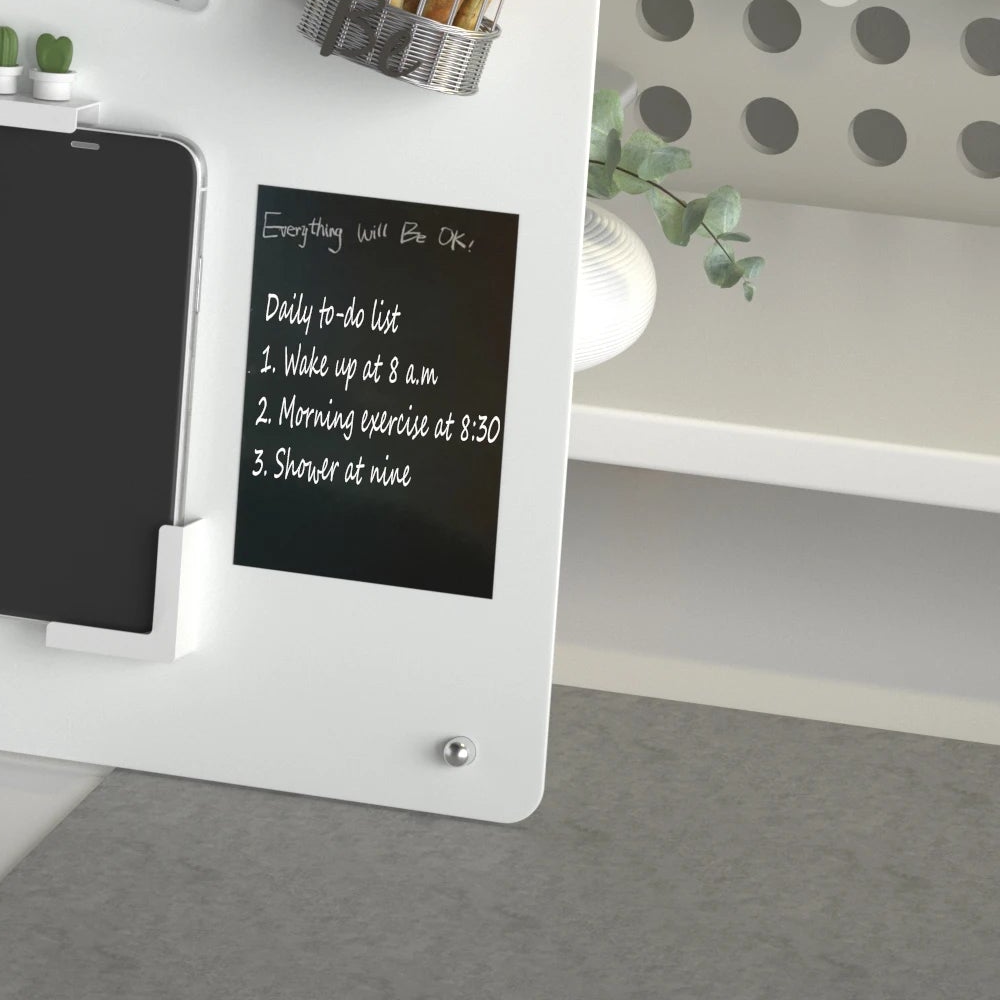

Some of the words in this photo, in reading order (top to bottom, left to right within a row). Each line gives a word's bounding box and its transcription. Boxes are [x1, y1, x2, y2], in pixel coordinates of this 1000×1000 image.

[262, 212, 343, 253] Everything
[266, 293, 313, 335] Daily
[319, 296, 364, 328] to-do
[371, 299, 401, 334] list
[285, 343, 328, 377] Wake
[335, 360, 356, 390] up
[363, 354, 383, 383] at
[389, 356, 399, 383] 8
[279, 394, 354, 440] Morning
[361, 405, 429, 440] exercise
[434, 412, 455, 441] at
[461, 415, 500, 443] 8:30
[274, 447, 339, 484] Shower
[345, 456, 365, 485] at
[370, 455, 411, 486] nine
